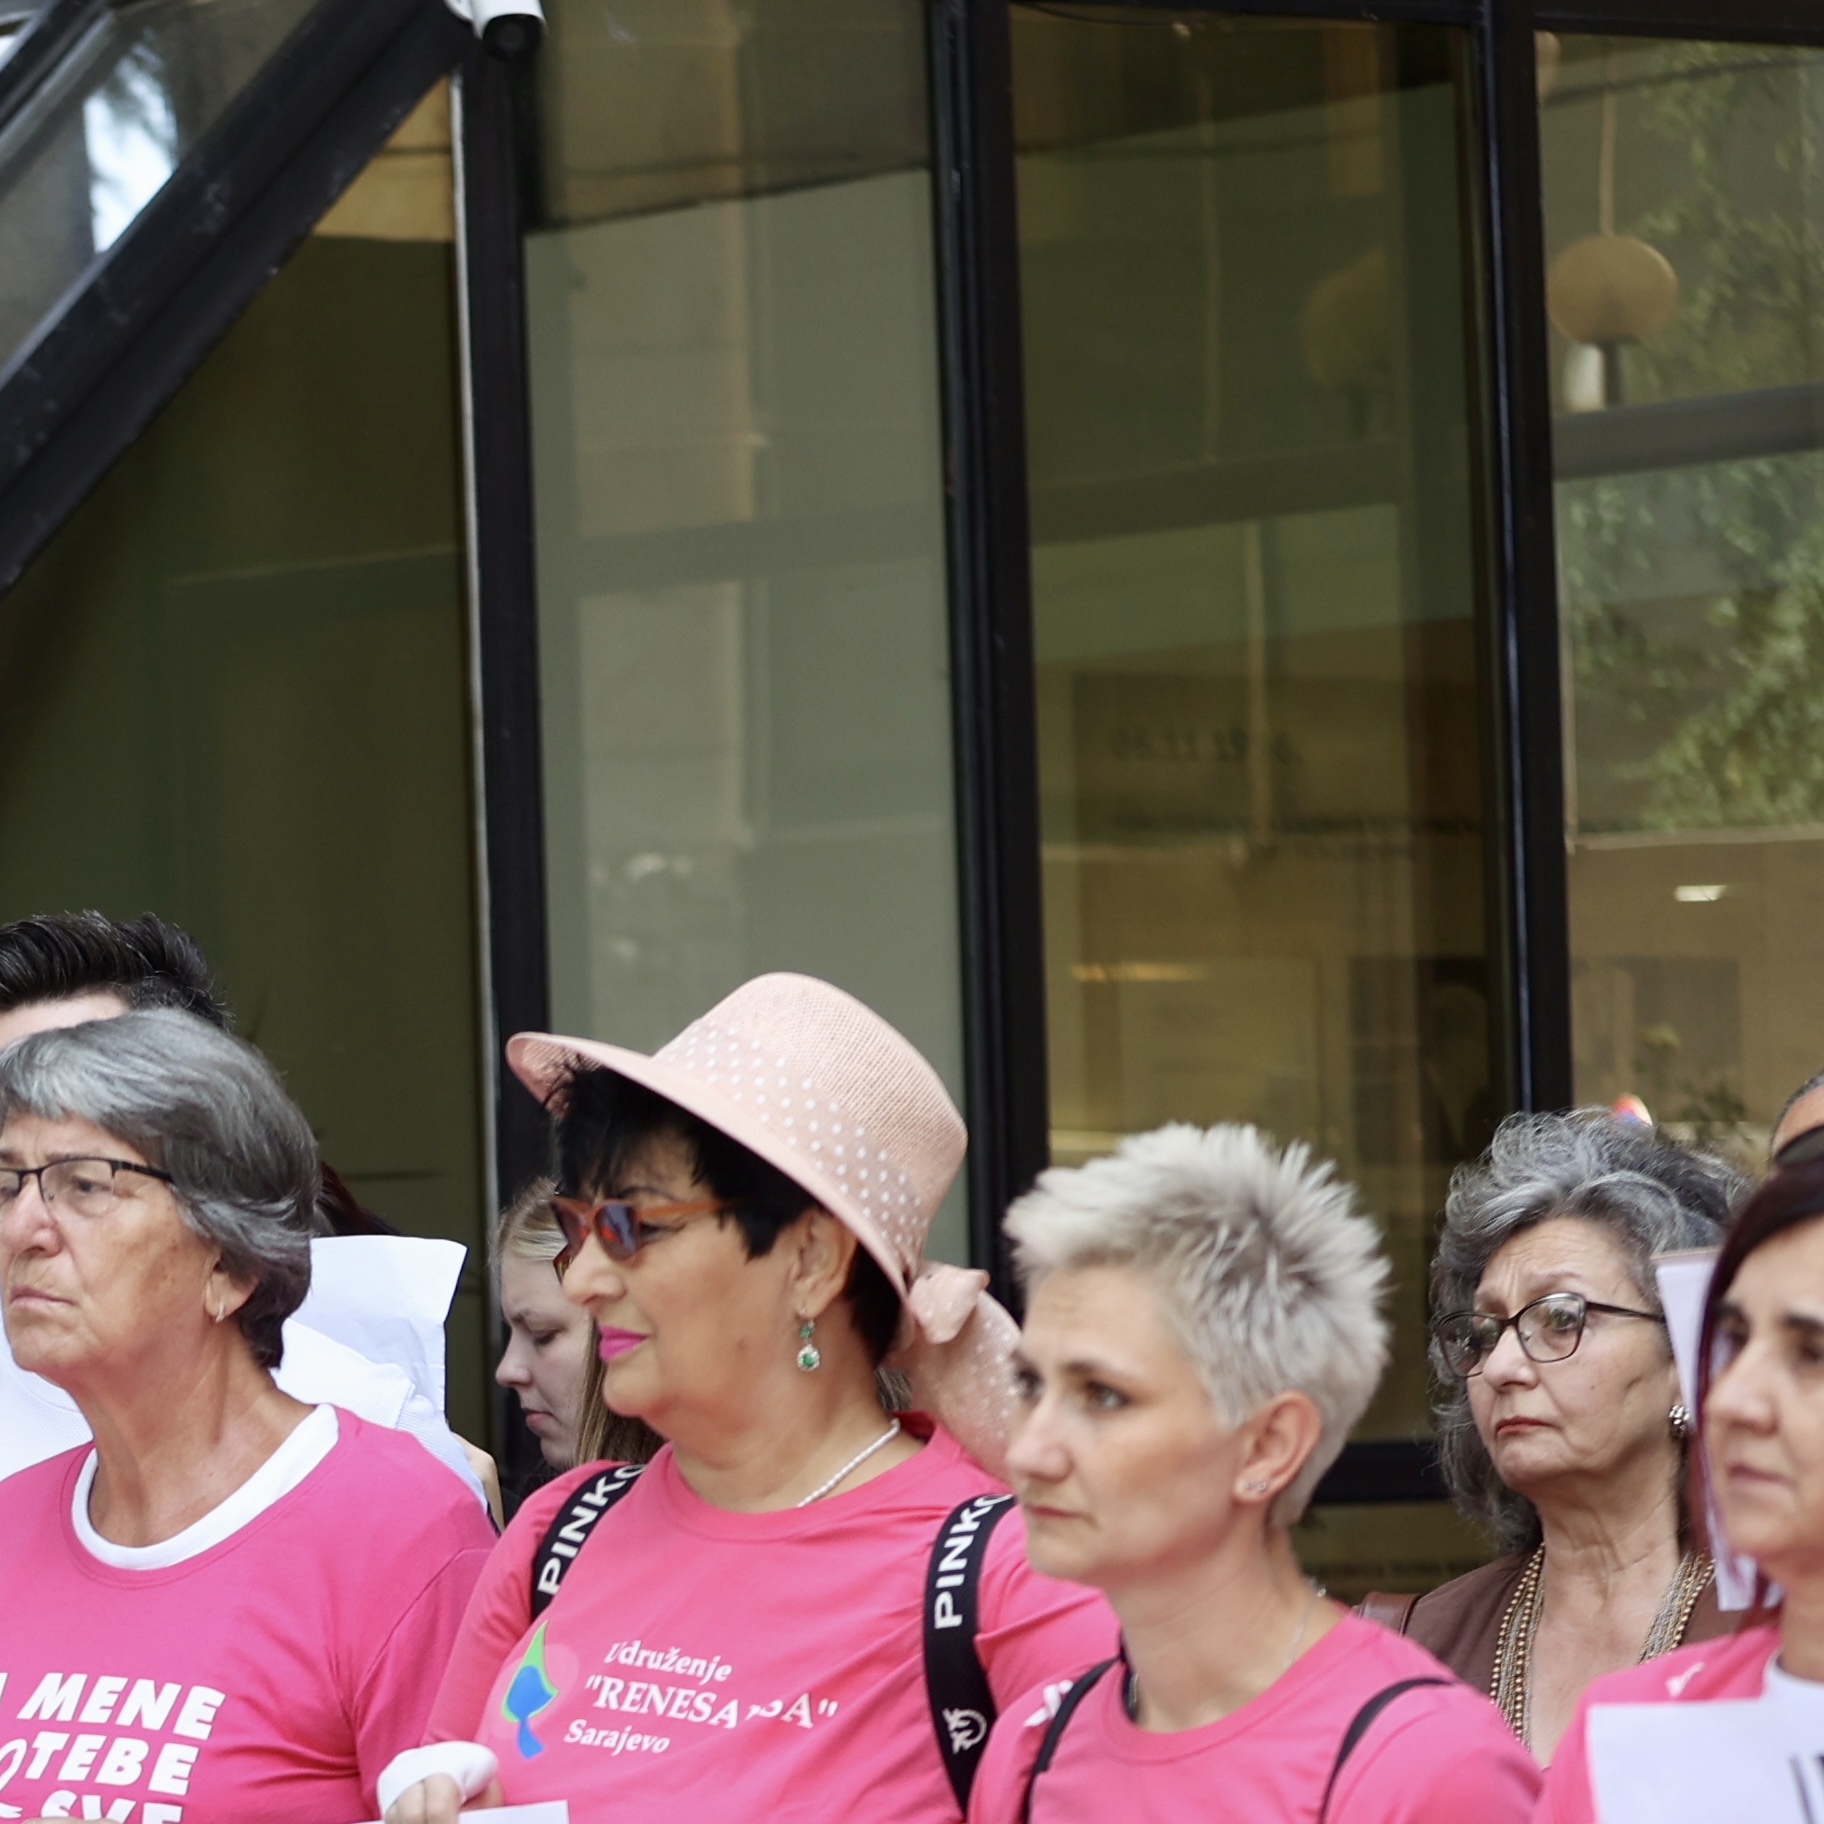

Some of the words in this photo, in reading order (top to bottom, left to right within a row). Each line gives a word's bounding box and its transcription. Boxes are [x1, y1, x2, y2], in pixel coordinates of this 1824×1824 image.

[16, 1671, 227, 1741] MENE
[563, 1718, 671, 1756] Sarajevo
[24, 1730, 200, 1796] TEBE
